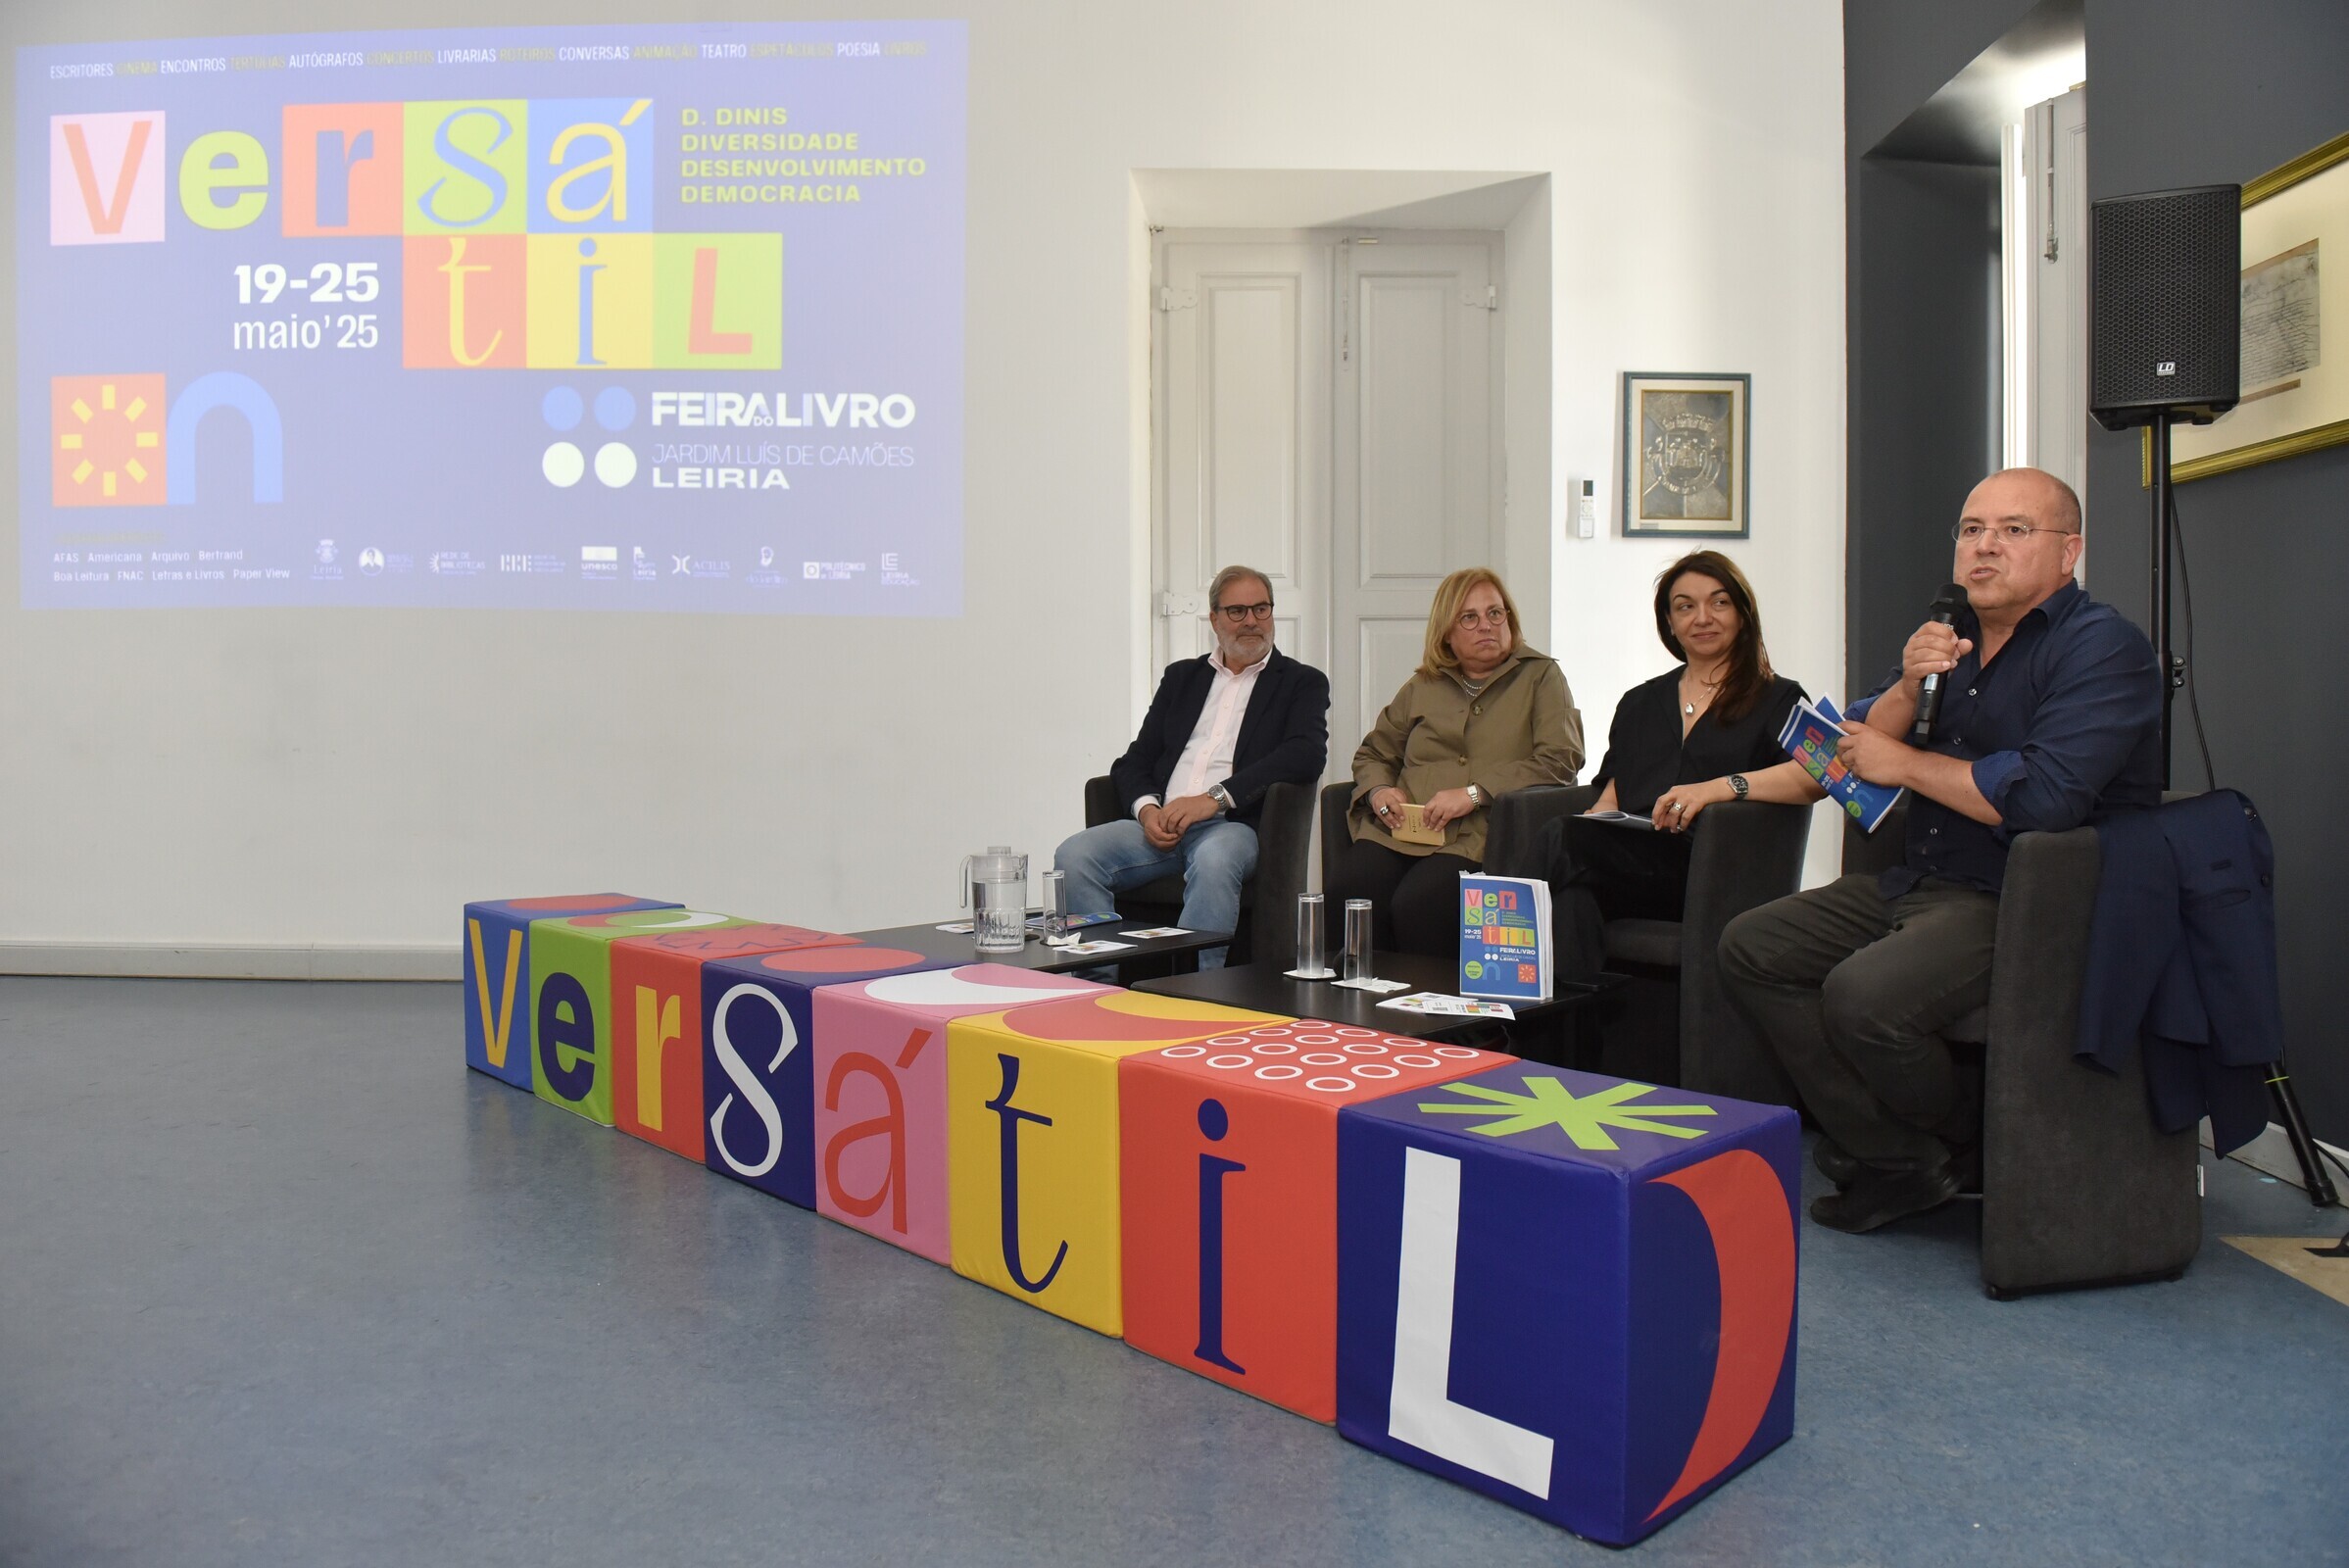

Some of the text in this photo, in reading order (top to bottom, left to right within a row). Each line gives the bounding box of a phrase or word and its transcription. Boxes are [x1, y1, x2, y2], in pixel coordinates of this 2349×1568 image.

[50, 63, 114, 78] ESCRITORES
[161, 58, 226, 74] ENCONTROS
[289, 50, 364, 69] AUTÓGRAFOS
[437, 49, 497, 64] LIVRARIAS
[499, 47, 555, 63] ROTEIROS
[559, 45, 629, 61] CONVERSAS
[702, 44, 747, 59] TEATRO
[837, 42, 880, 57] POESIA
[681, 108, 788, 126] D. DINIS
[681, 133, 858, 152] DIVERSIDADE
[681, 158, 926, 177] DESENVOLVIMENTO
[681, 184, 860, 204] DEMOCRACIA
[233, 263, 379, 304] 19-25
[652, 392, 771, 427] FEIRA
[777, 393, 915, 428] LIVRO
[652, 440, 914, 467] JARDIM LUÍS DE CAMÕES
[652, 467, 790, 489] LEIRIA
[53, 549, 243, 564] AFAS Americana Arquivo Bertrand
[53, 567, 290, 582] Boa Leitura FNAC Letras e Livros Paper View
[581, 563, 617, 571] unesco
